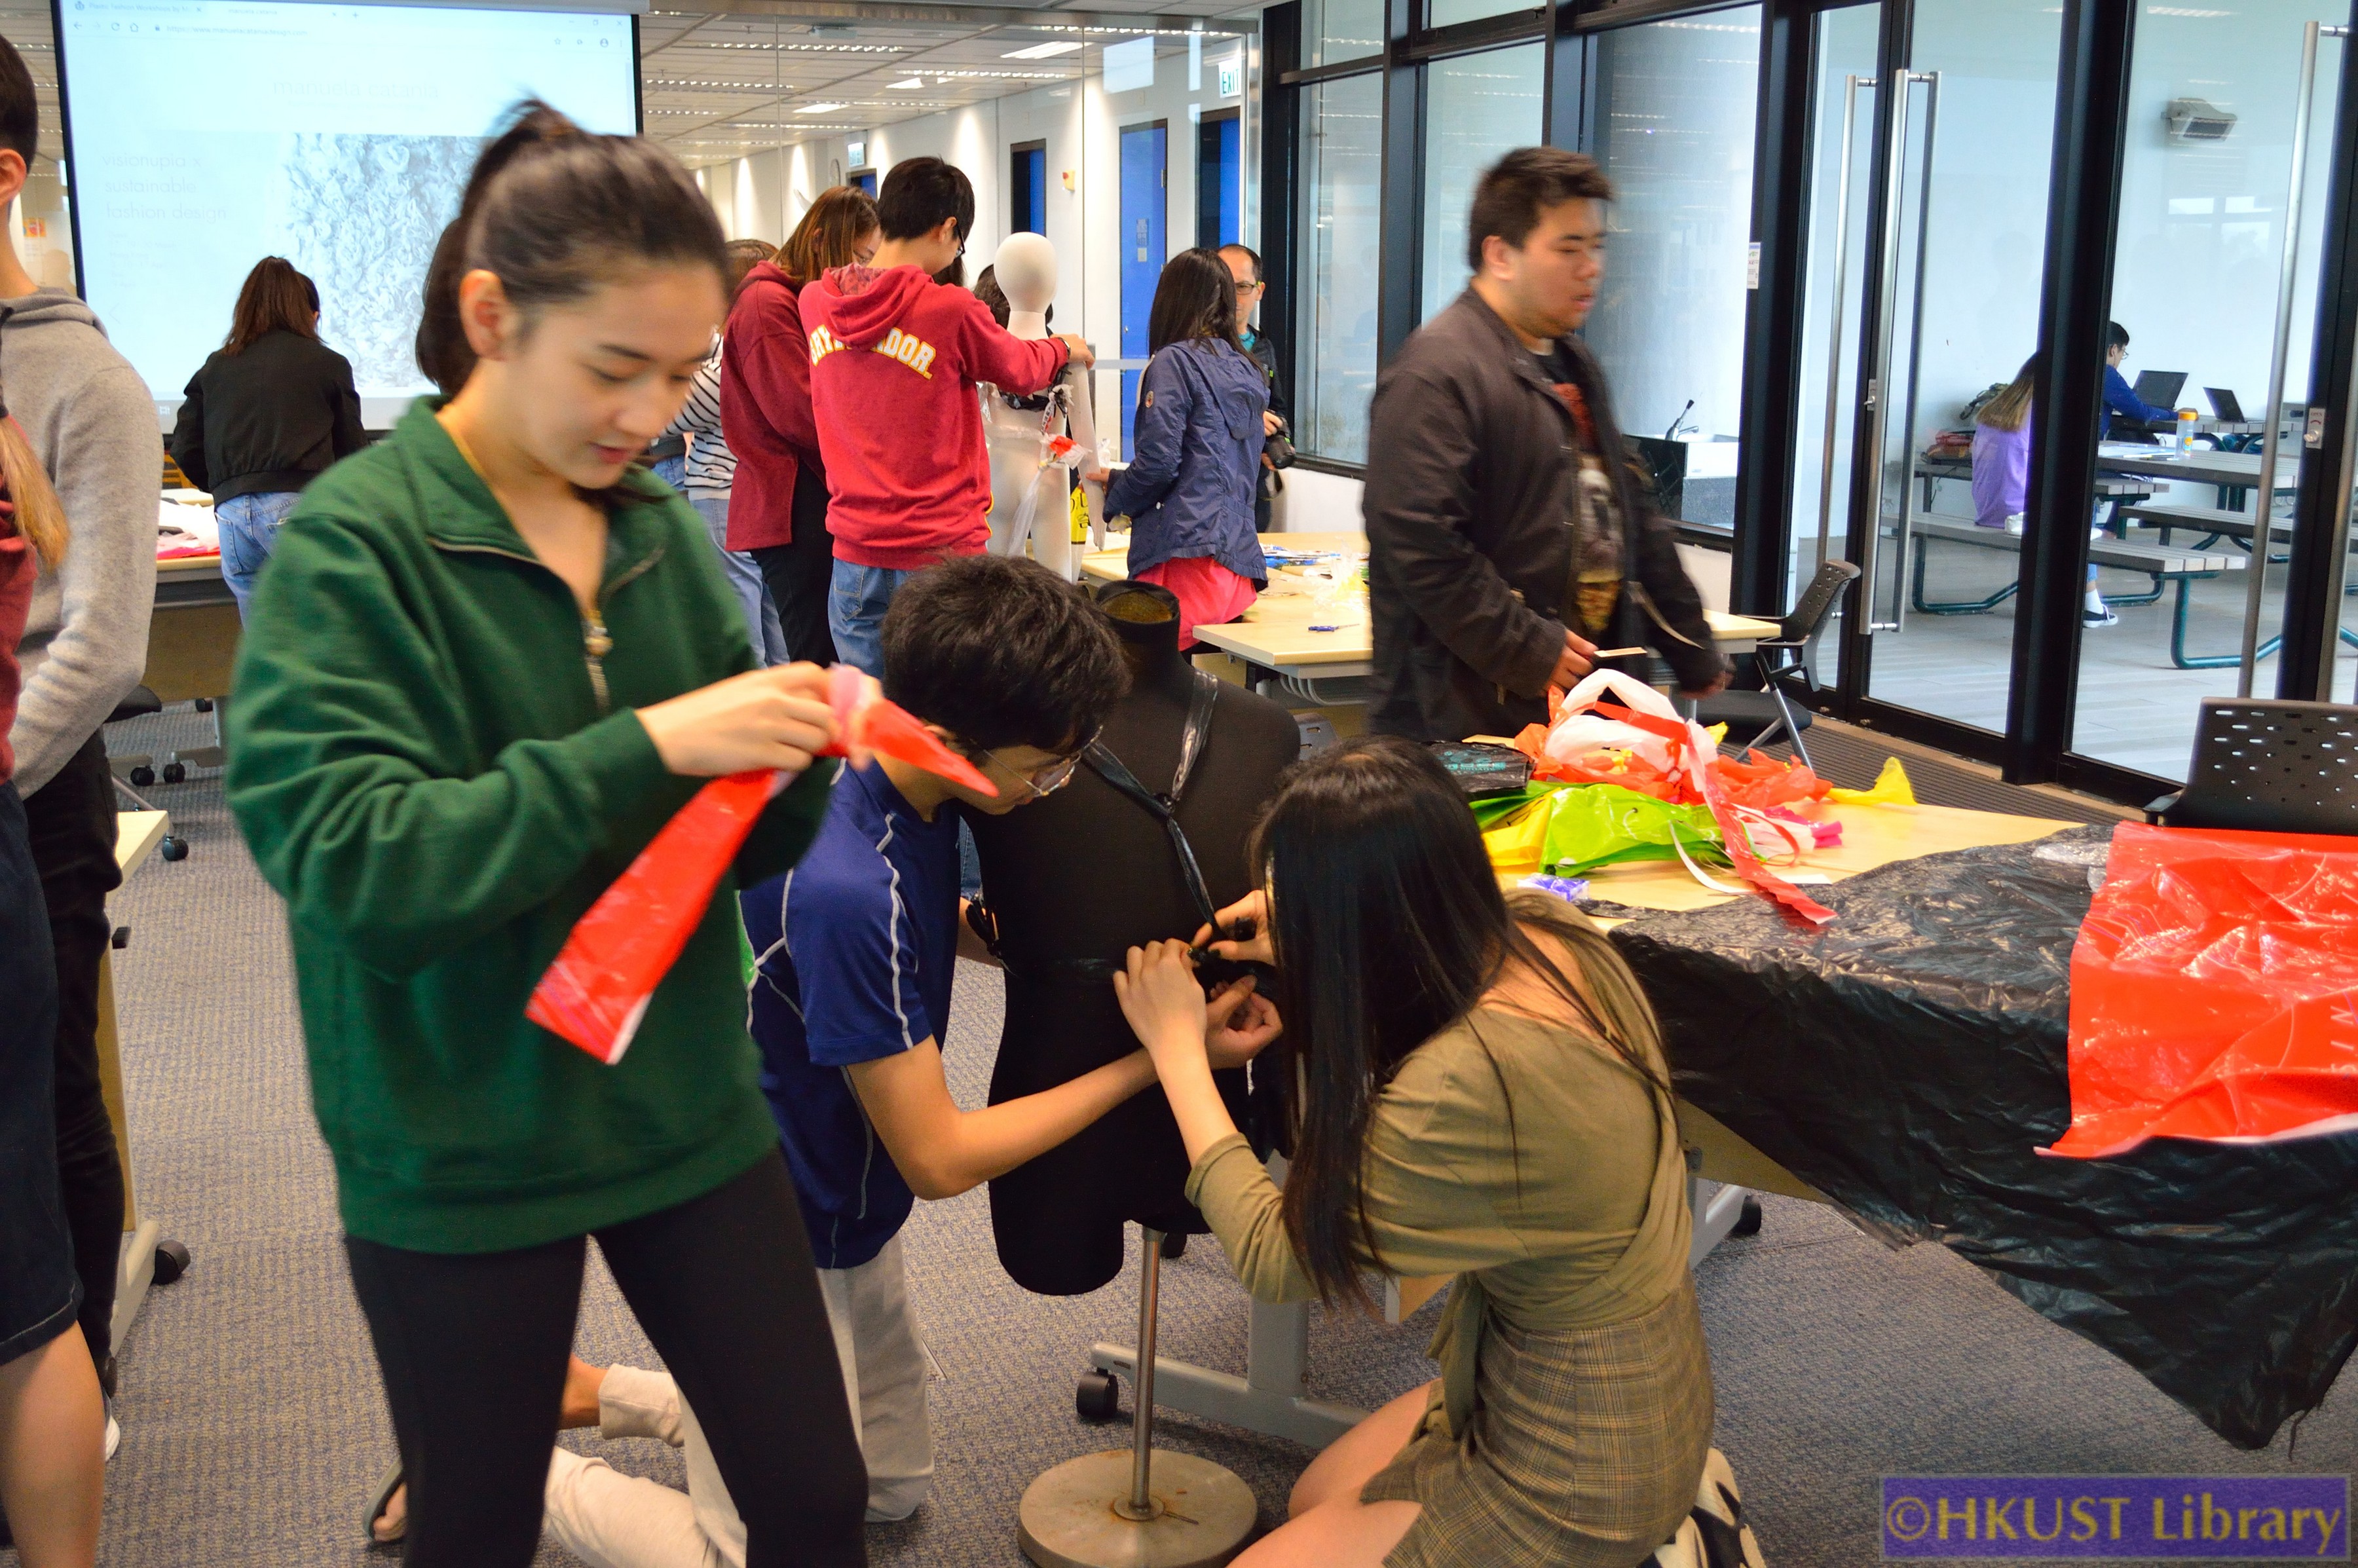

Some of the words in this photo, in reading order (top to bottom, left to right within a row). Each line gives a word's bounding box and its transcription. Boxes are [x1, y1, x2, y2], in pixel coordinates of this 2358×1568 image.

[273, 79, 361, 96] manuela
[368, 83, 439, 99] catania
[1222, 69, 1239, 94] EXIT
[101, 152, 186, 171] visionupia
[105, 176, 196, 193] sustainable
[106, 201, 166, 219] fashion
[172, 202, 227, 223] design
